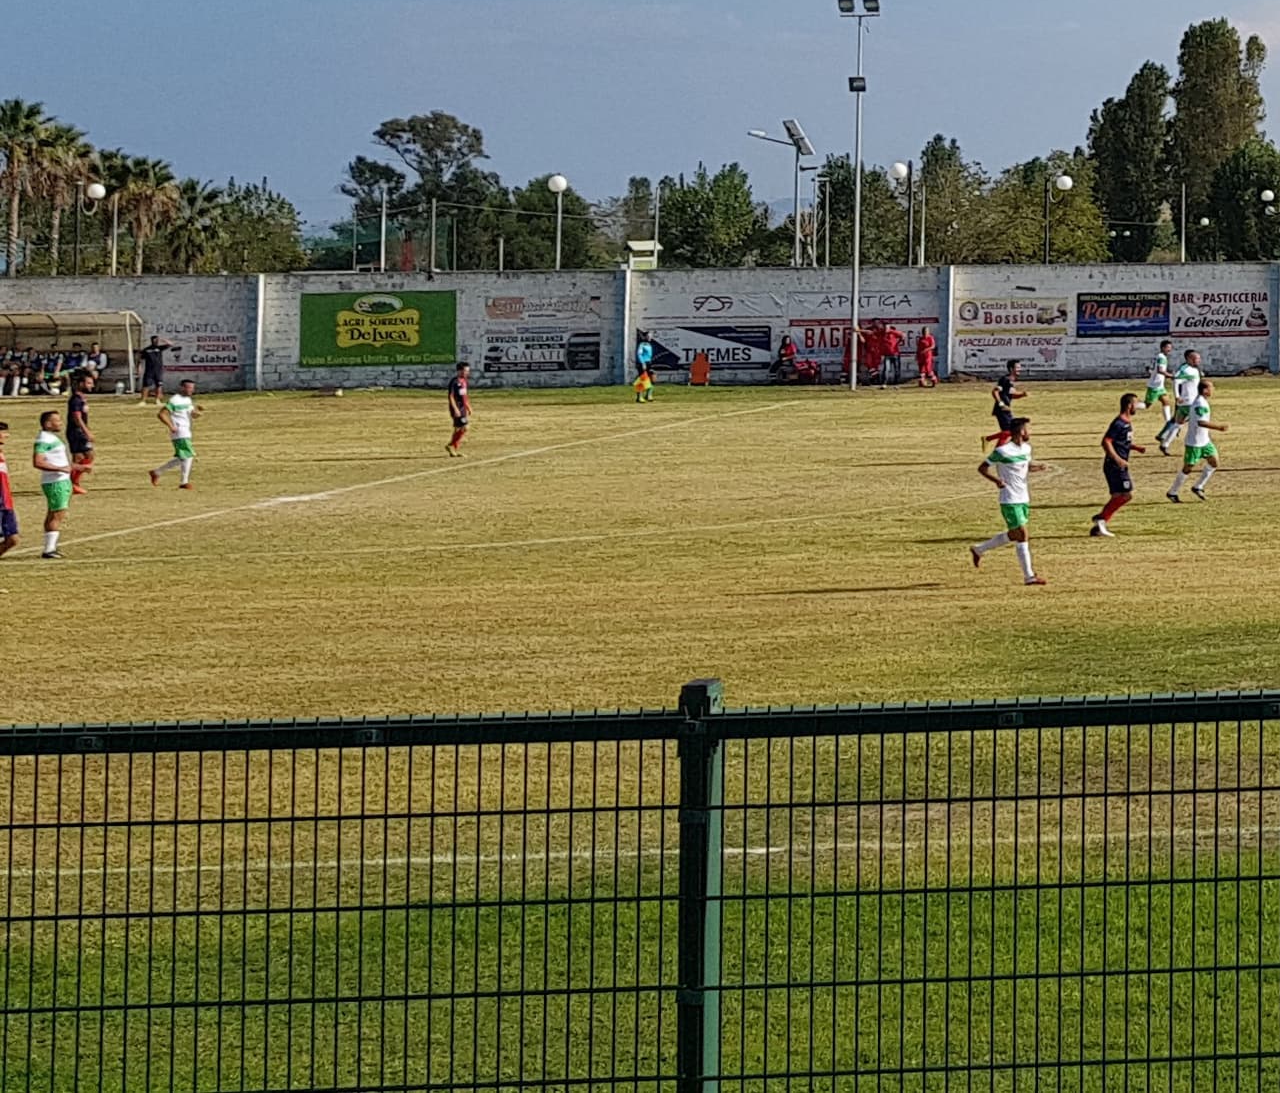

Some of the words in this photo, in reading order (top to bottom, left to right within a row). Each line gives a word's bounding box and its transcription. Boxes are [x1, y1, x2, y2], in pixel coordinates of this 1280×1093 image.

[1172, 293, 1194, 303] BAR
[1203, 292, 1269, 303] PASTICCERIA
[1082, 301, 1166, 320] Palmieri
[1198, 304, 1244, 317] Delizie
[343, 318, 365, 326] AGRI
[984, 311, 1034, 324] Bossio
[197, 344, 237, 352] PIZZERIA
[959, 338, 1012, 347] MACELLERIA
[191, 354, 237, 363] Calabria
[505, 346, 561, 361] GALATI
